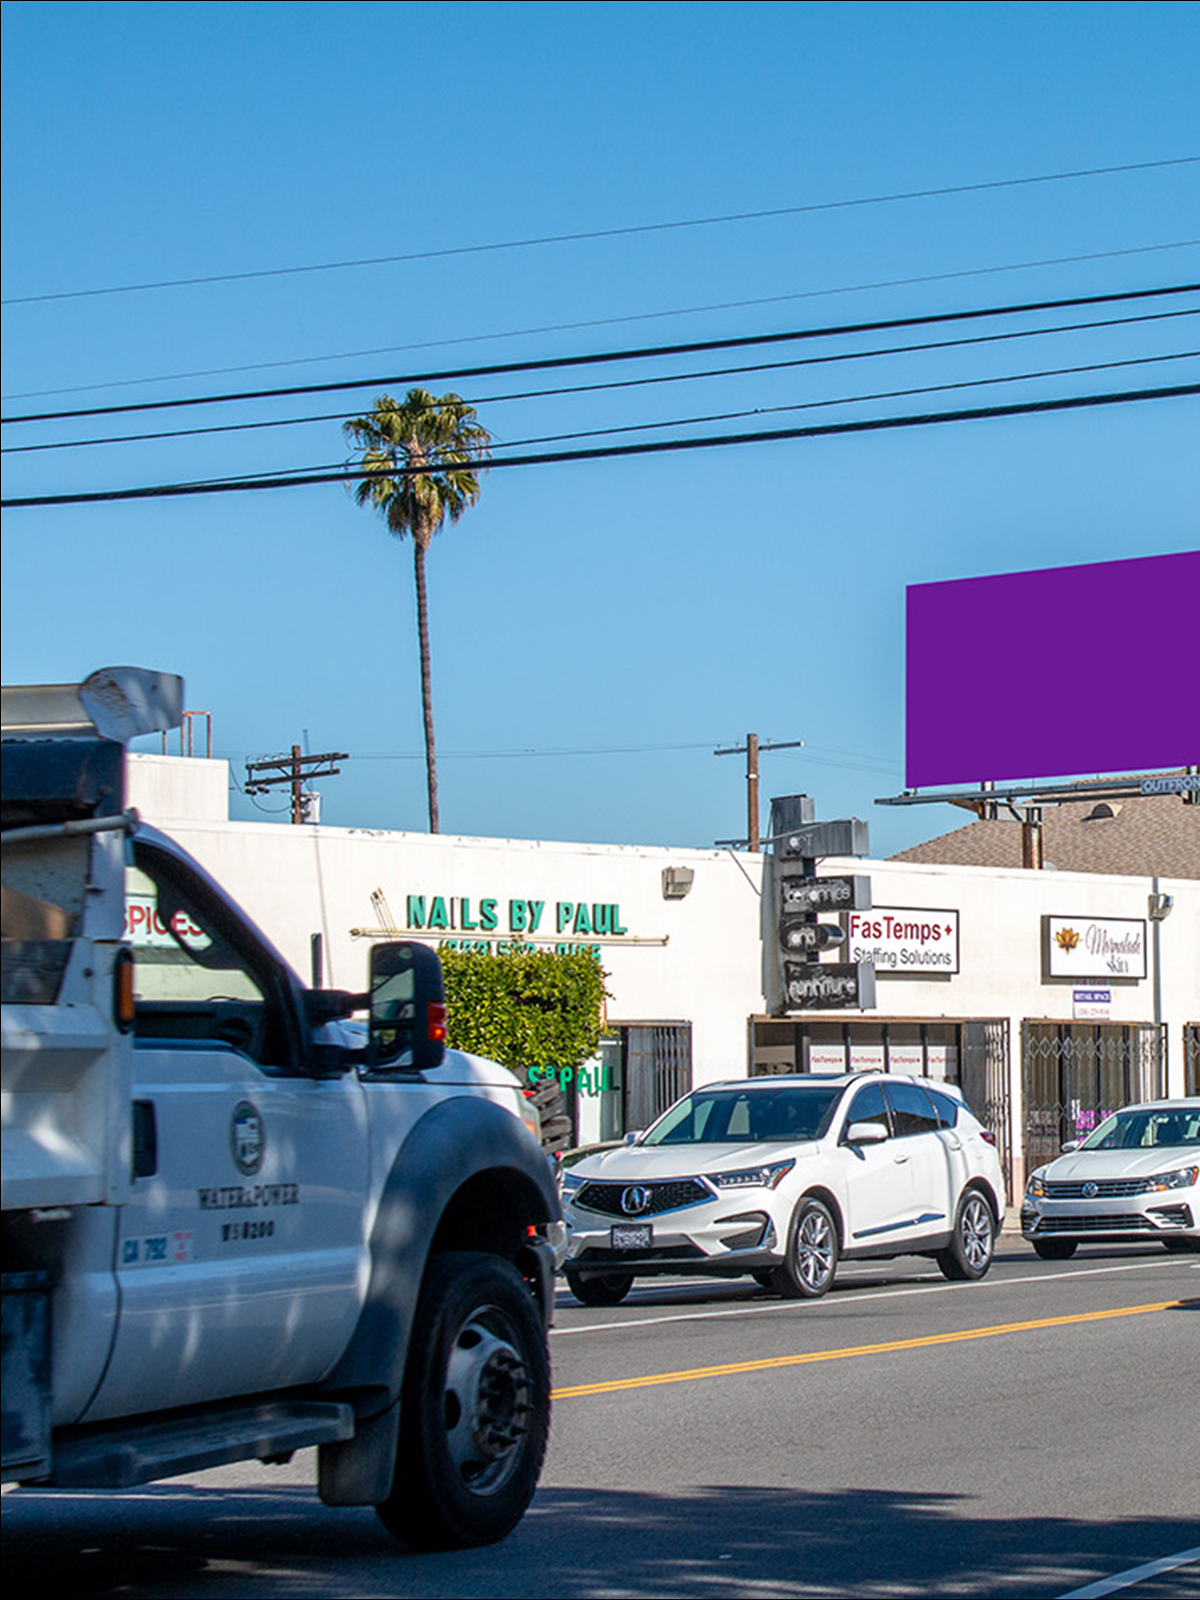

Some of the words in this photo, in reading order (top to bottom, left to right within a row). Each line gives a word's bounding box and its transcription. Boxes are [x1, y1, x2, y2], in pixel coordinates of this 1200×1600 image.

[127, 905, 205, 936] PICES
[406, 895, 498, 931] NAILS
[509, 899, 546, 933] BY
[556, 902, 628, 936] PAUL
[850, 914, 942, 946] FasTemps
[1085, 923, 1142, 956] Marmalade
[853, 946, 898, 968] Staffing
[900, 947, 952, 966] Solutions
[560, 1065, 620, 1092] PAUL
